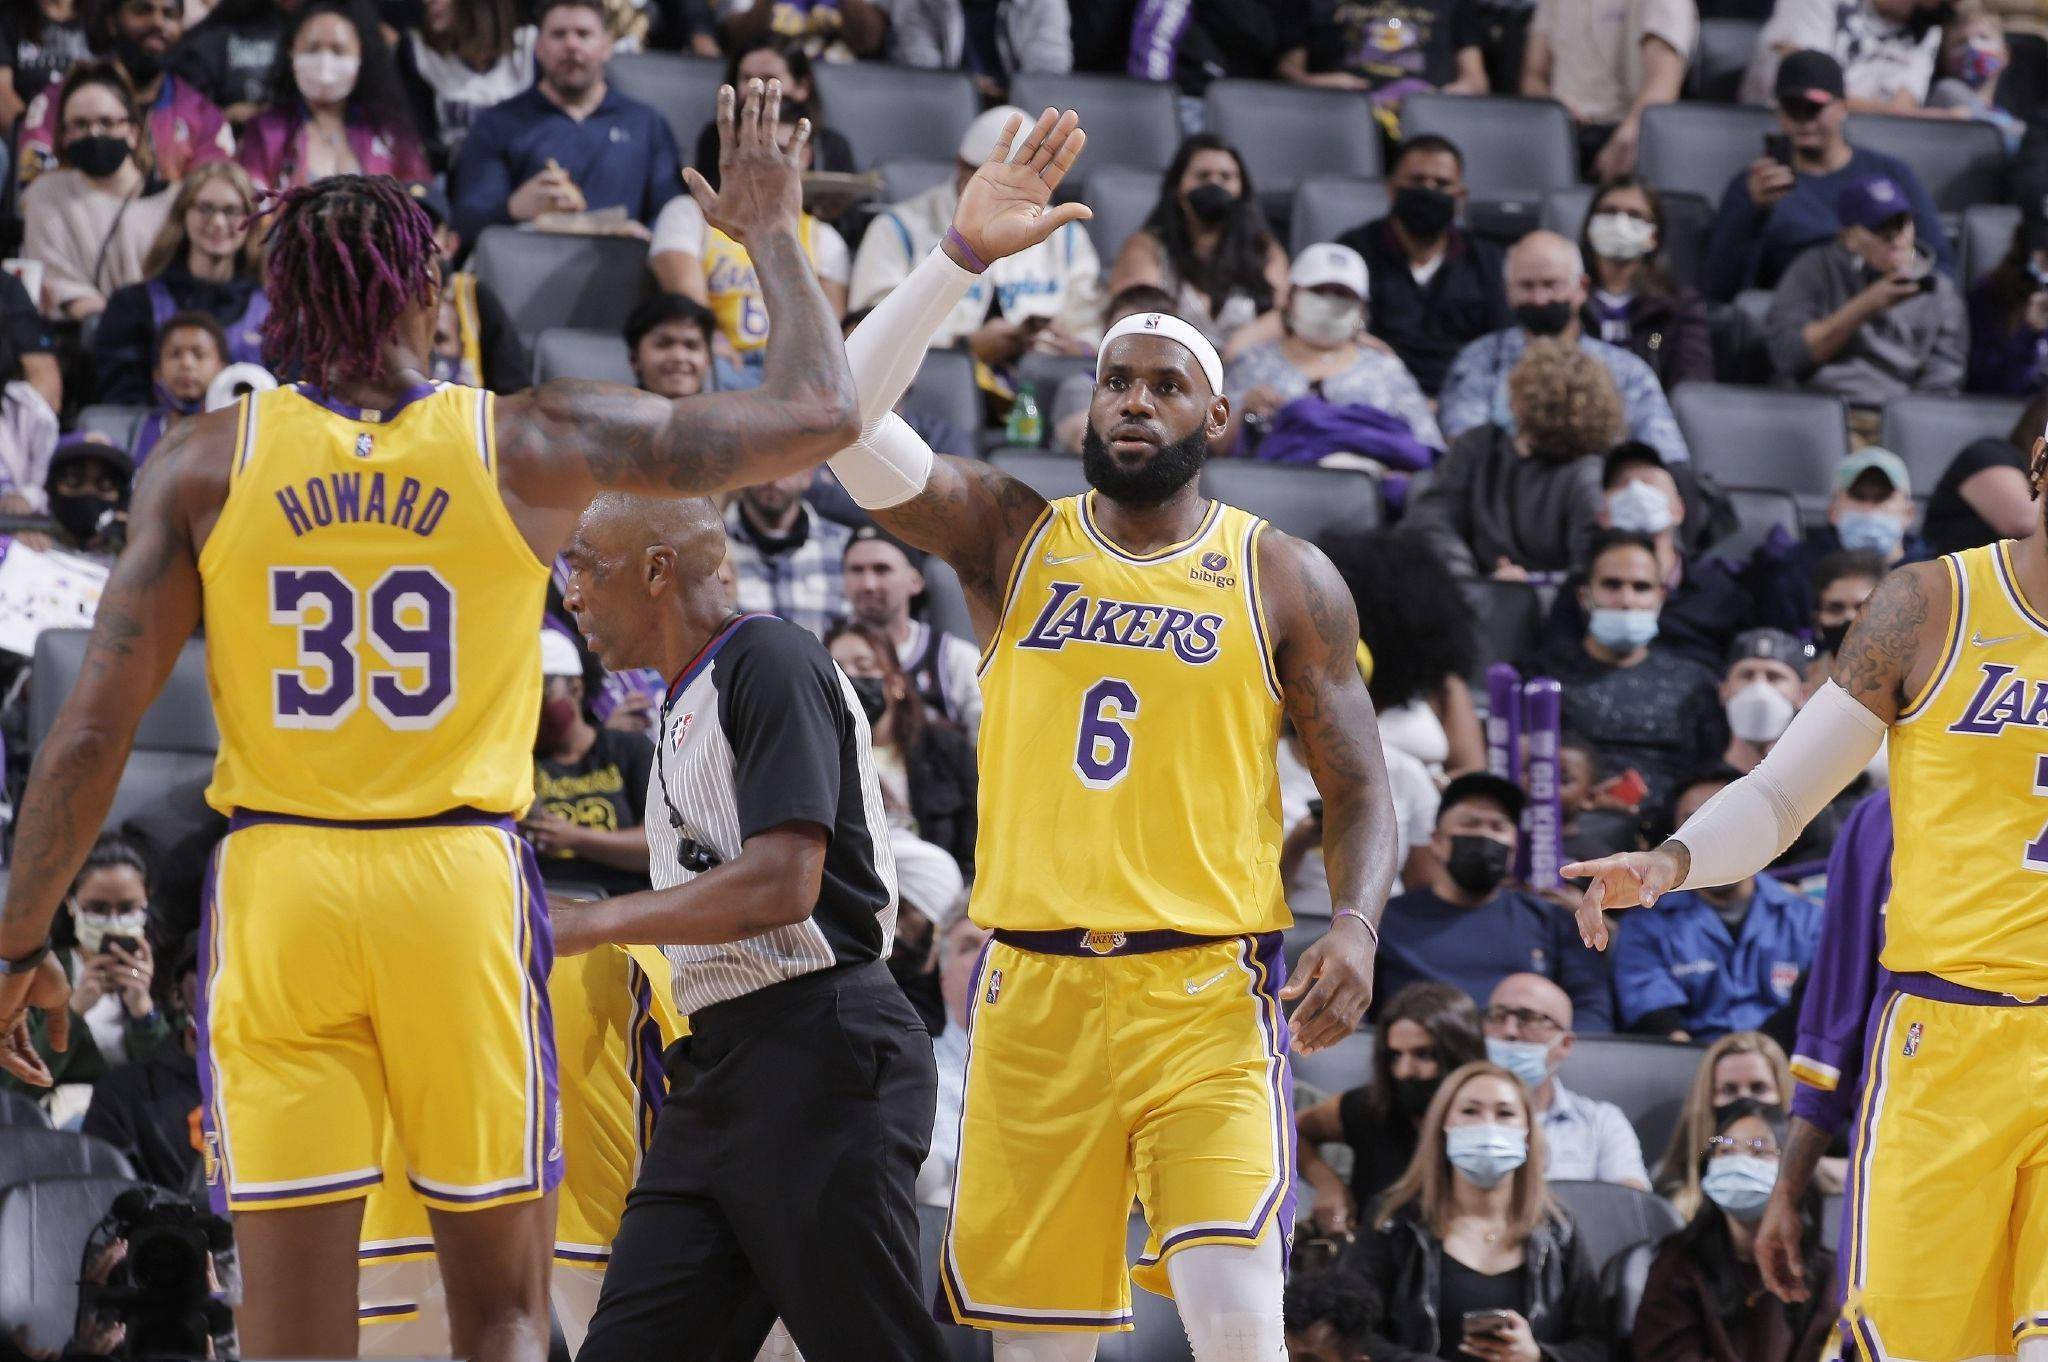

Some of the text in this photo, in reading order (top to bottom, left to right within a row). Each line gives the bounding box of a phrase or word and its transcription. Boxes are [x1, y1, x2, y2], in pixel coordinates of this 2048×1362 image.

[274, 471, 450, 538] HOWARD
[1189, 567, 1236, 588] bibigo
[268, 565, 459, 732] 39
[1016, 581, 1225, 665] LAKERS
[1072, 676, 1140, 790] 6
[1531, 805, 1558, 889] KINGS
